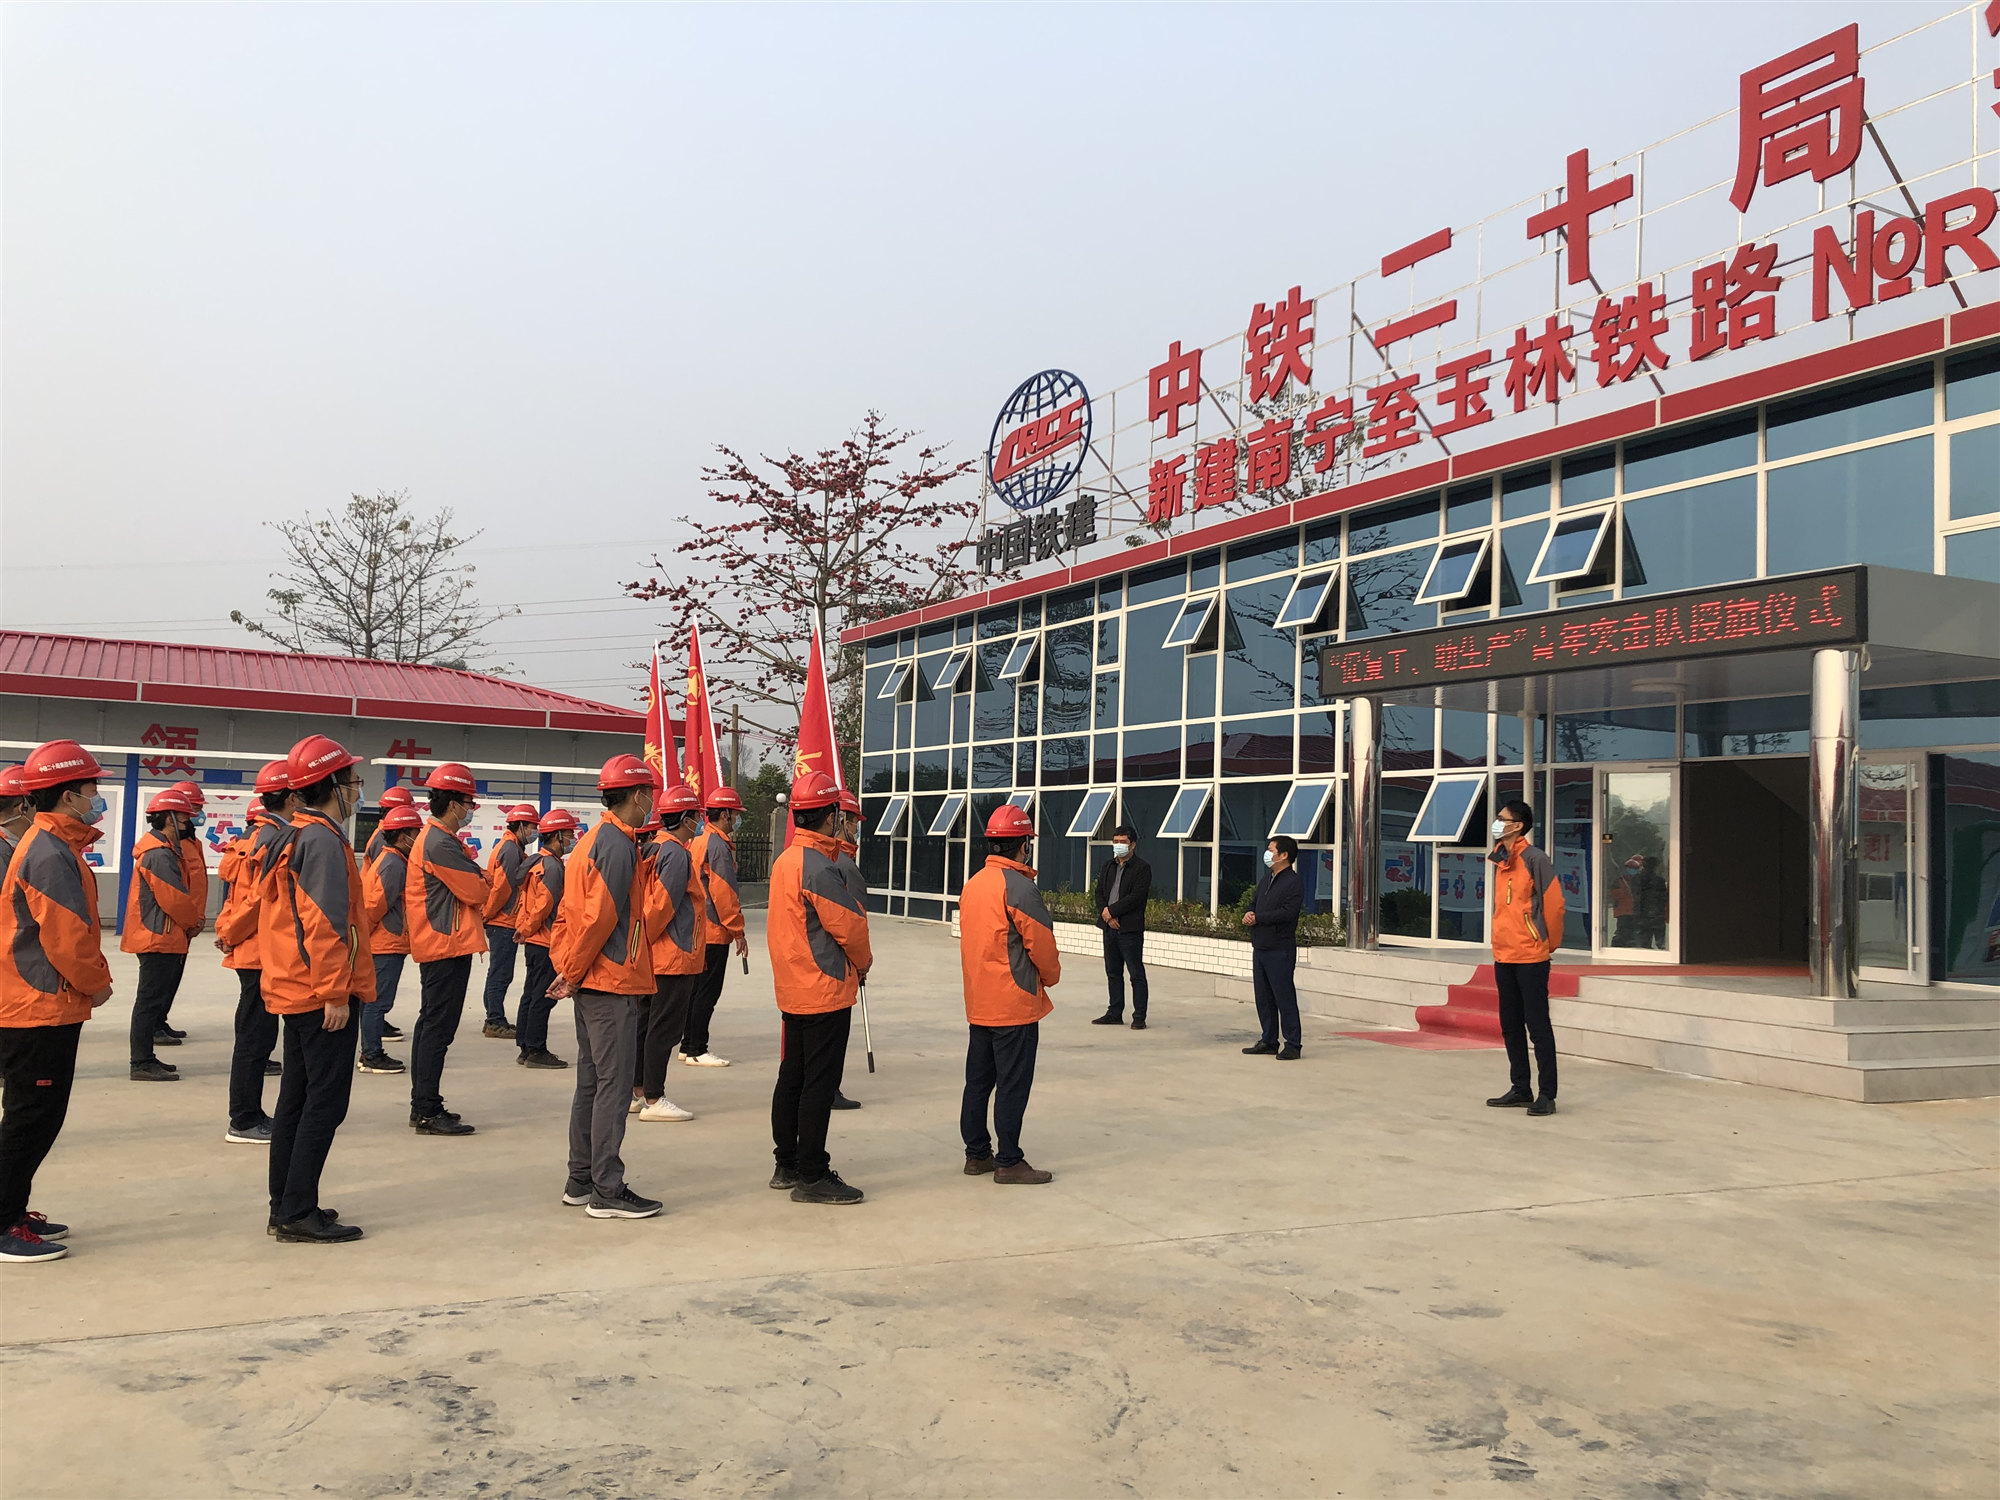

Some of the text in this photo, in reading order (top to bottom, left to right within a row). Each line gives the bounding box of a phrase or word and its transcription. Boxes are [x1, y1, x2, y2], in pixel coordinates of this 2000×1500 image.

[1149, 0, 2000, 439] 中铁二十局
[993, 397, 1085, 483] CRCC
[976, 494, 1098, 576] 中国铁建
